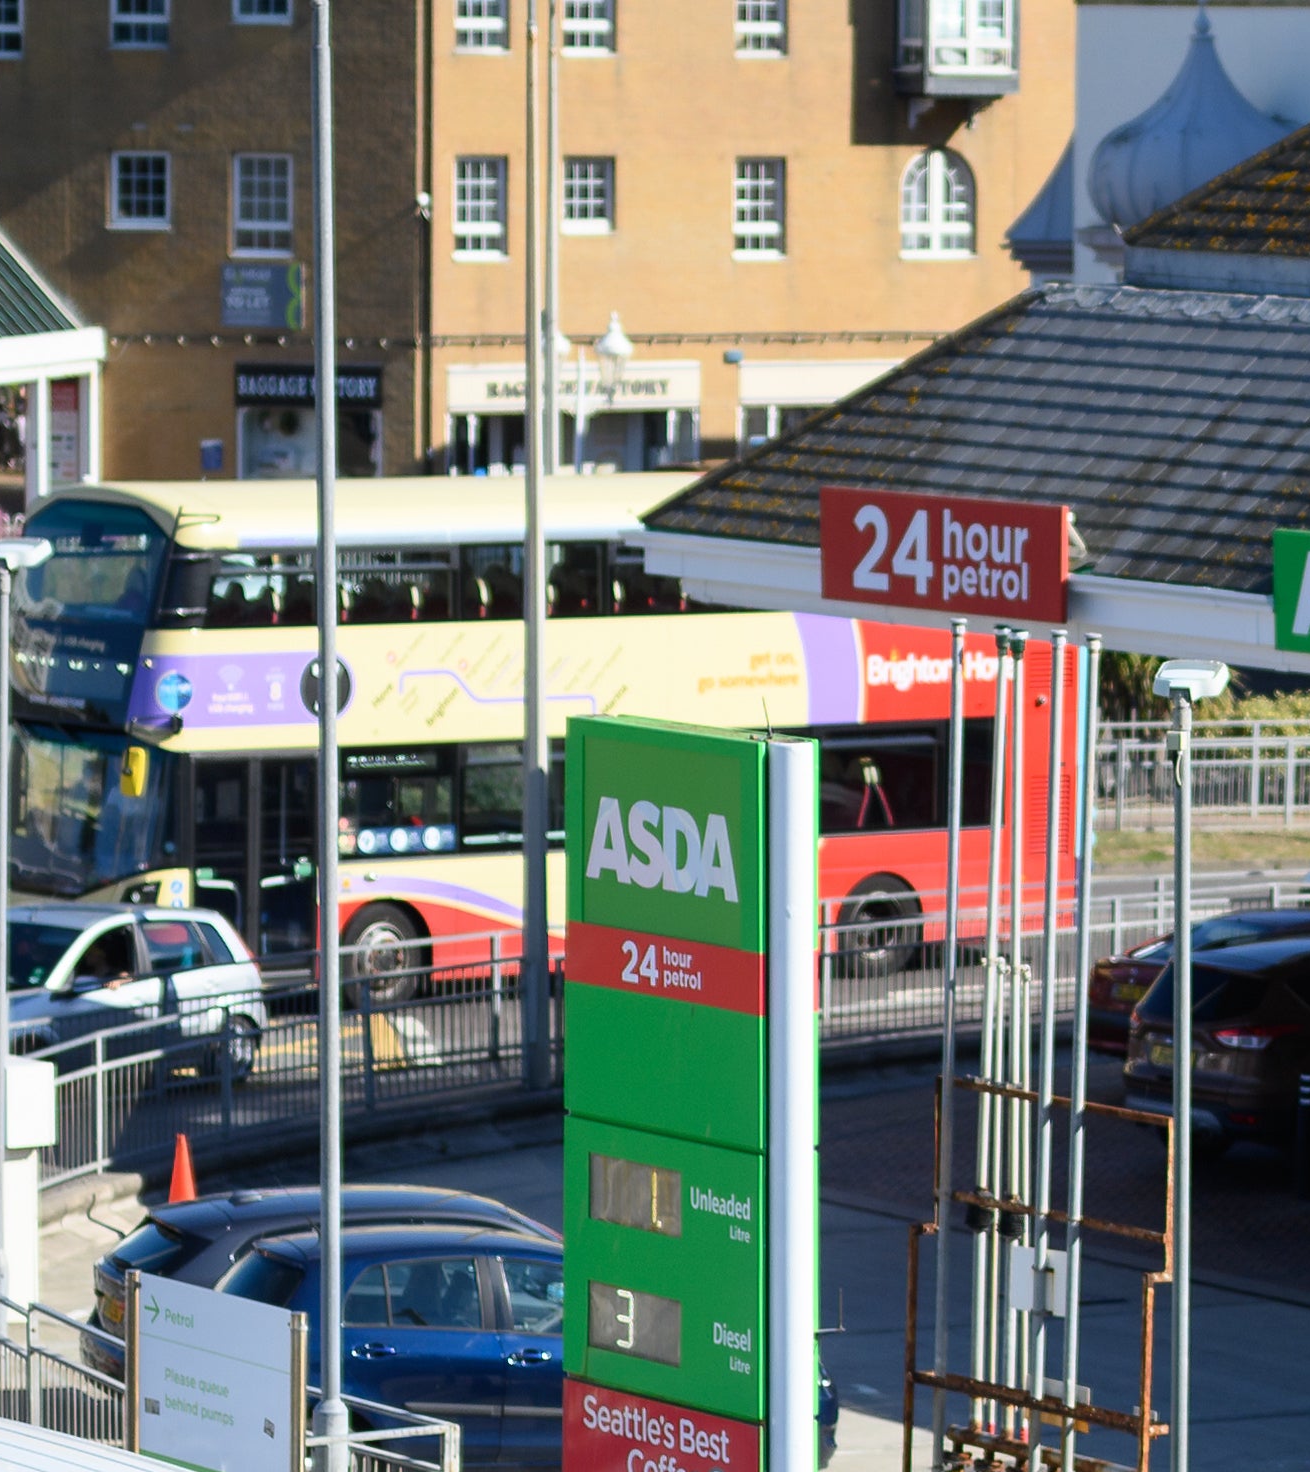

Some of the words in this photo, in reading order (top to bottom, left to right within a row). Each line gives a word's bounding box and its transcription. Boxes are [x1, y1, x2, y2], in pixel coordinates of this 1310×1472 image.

[236, 375, 308, 397] BAGGAGE
[853, 503, 934, 596] 24
[943, 508, 1028, 564] hour
[943, 561, 1028, 601] petrol
[586, 796, 739, 903] ASDA
[621, 940, 658, 986] 24
[663, 945, 692, 969] hour
[663, 969, 702, 991] petrol
[690, 1185, 751, 1221] Unleaded
[729, 1225, 751, 1244] Litre
[165, 1307, 195, 1329] Petrol
[616, 1288, 635, 1349] 3
[713, 1321, 751, 1353] Diesel
[729, 1356, 751, 1375] Litre
[164, 1367, 197, 1390] Please
[198, 1378, 230, 1399] queue
[164, 1393, 199, 1417] behind
[201, 1405, 235, 1427] pumps
[583, 1394, 675, 1450] Seattle's
[679, 1417, 731, 1464] Best
